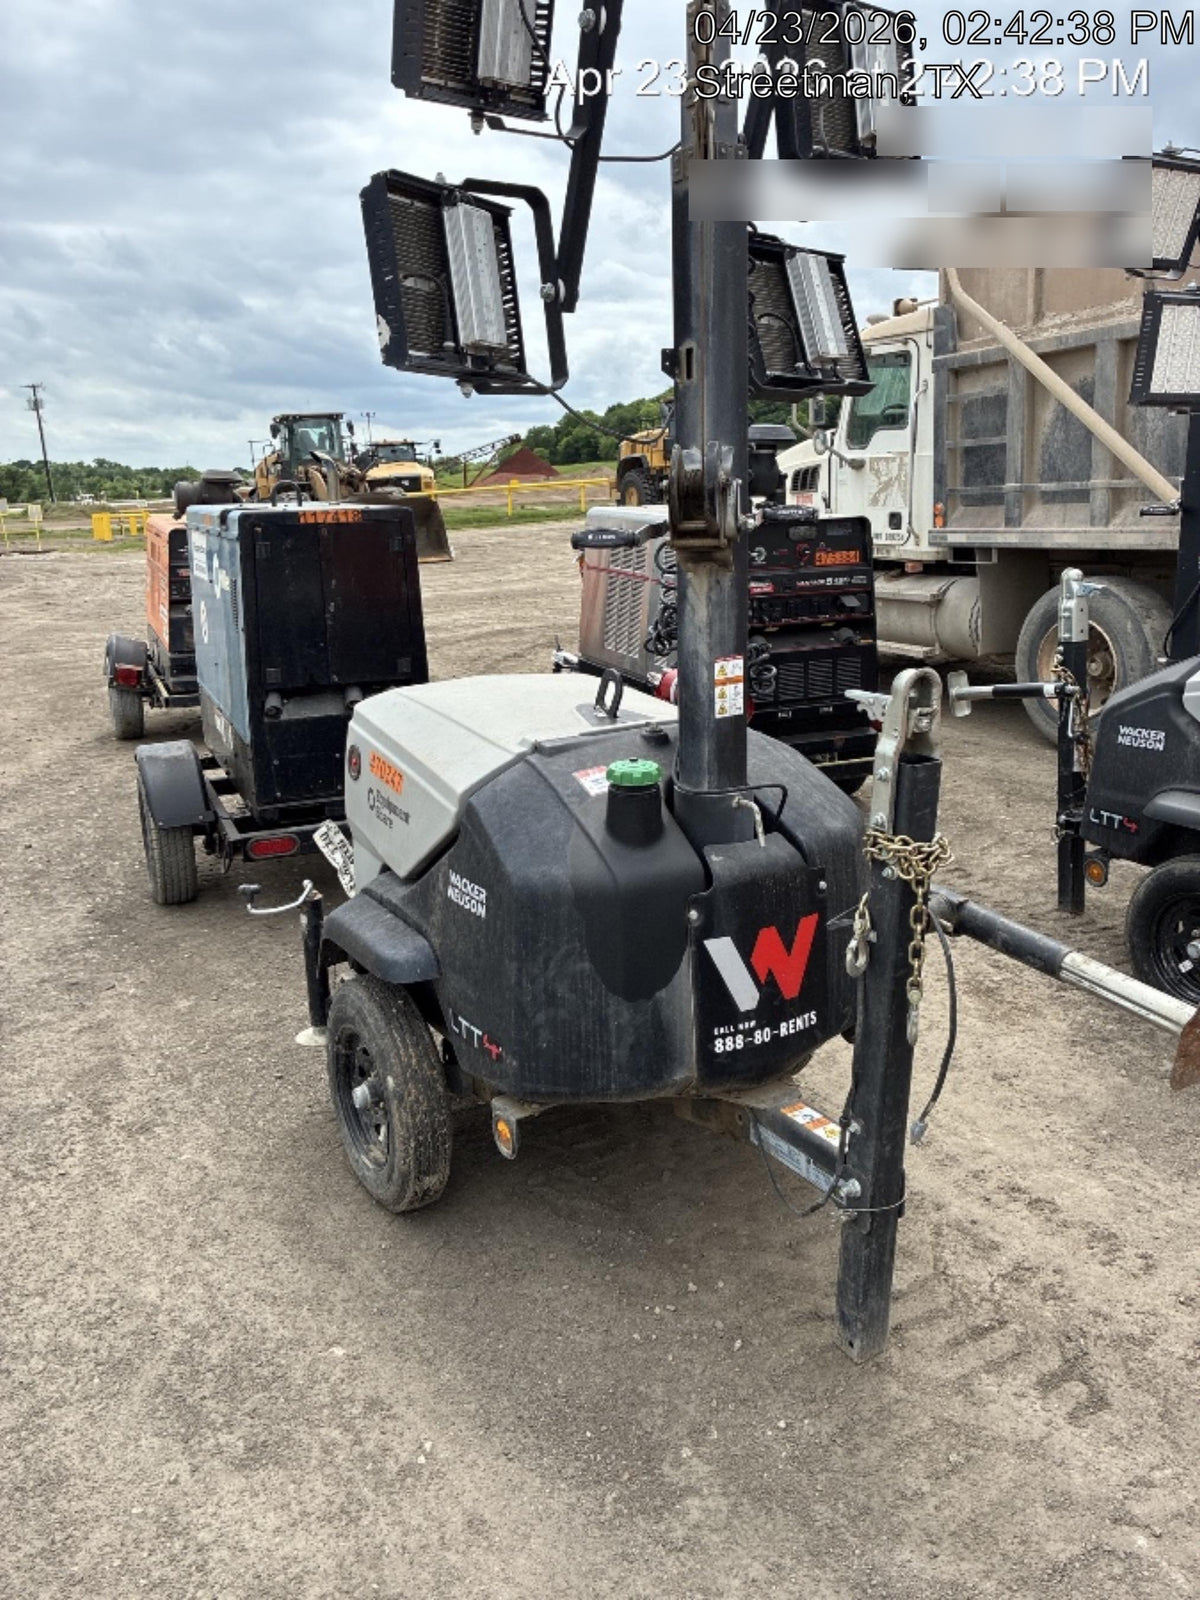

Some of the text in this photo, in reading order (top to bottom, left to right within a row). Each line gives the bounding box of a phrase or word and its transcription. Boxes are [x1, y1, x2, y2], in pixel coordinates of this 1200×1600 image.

[1118, 734, 1164, 751] NEUSON
[1119, 724, 1165, 741] WACKER
[1089, 807, 1138, 833] LTT4
[447, 885, 486, 919] NEUSON
[449, 869, 487, 904] WACKER
[448, 1007, 501, 1061] LTT4
[714, 1010, 818, 1054] 888-80-RENTS
